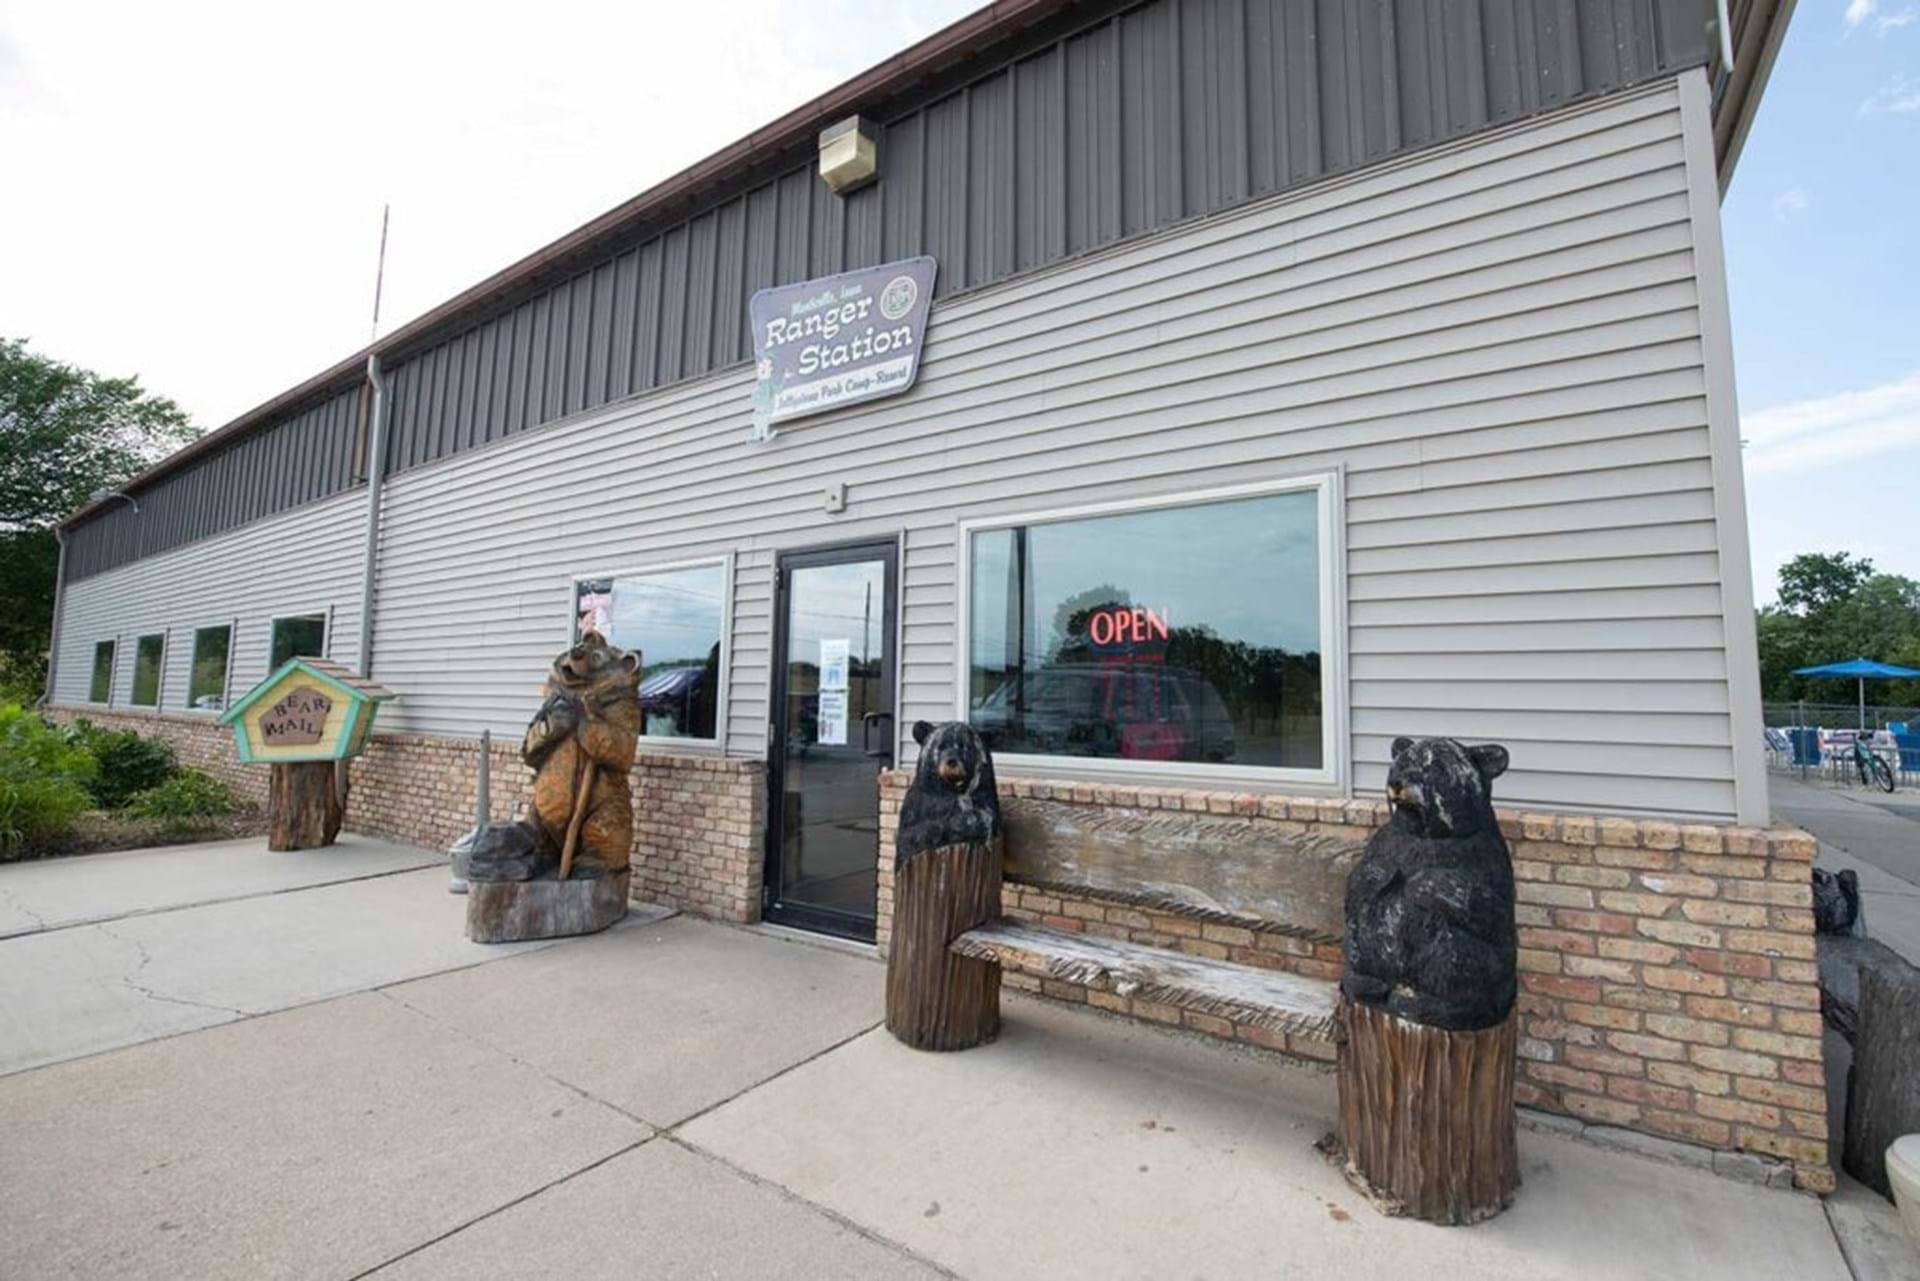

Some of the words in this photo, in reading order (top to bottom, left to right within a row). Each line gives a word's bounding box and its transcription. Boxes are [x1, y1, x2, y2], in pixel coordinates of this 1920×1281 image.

[765, 296, 873, 349] Ranger
[798, 325, 913, 375] Station
[1090, 607, 1168, 645] OPEN
[273, 695, 325, 717] BEAR
[264, 718, 318, 736] MAIL
